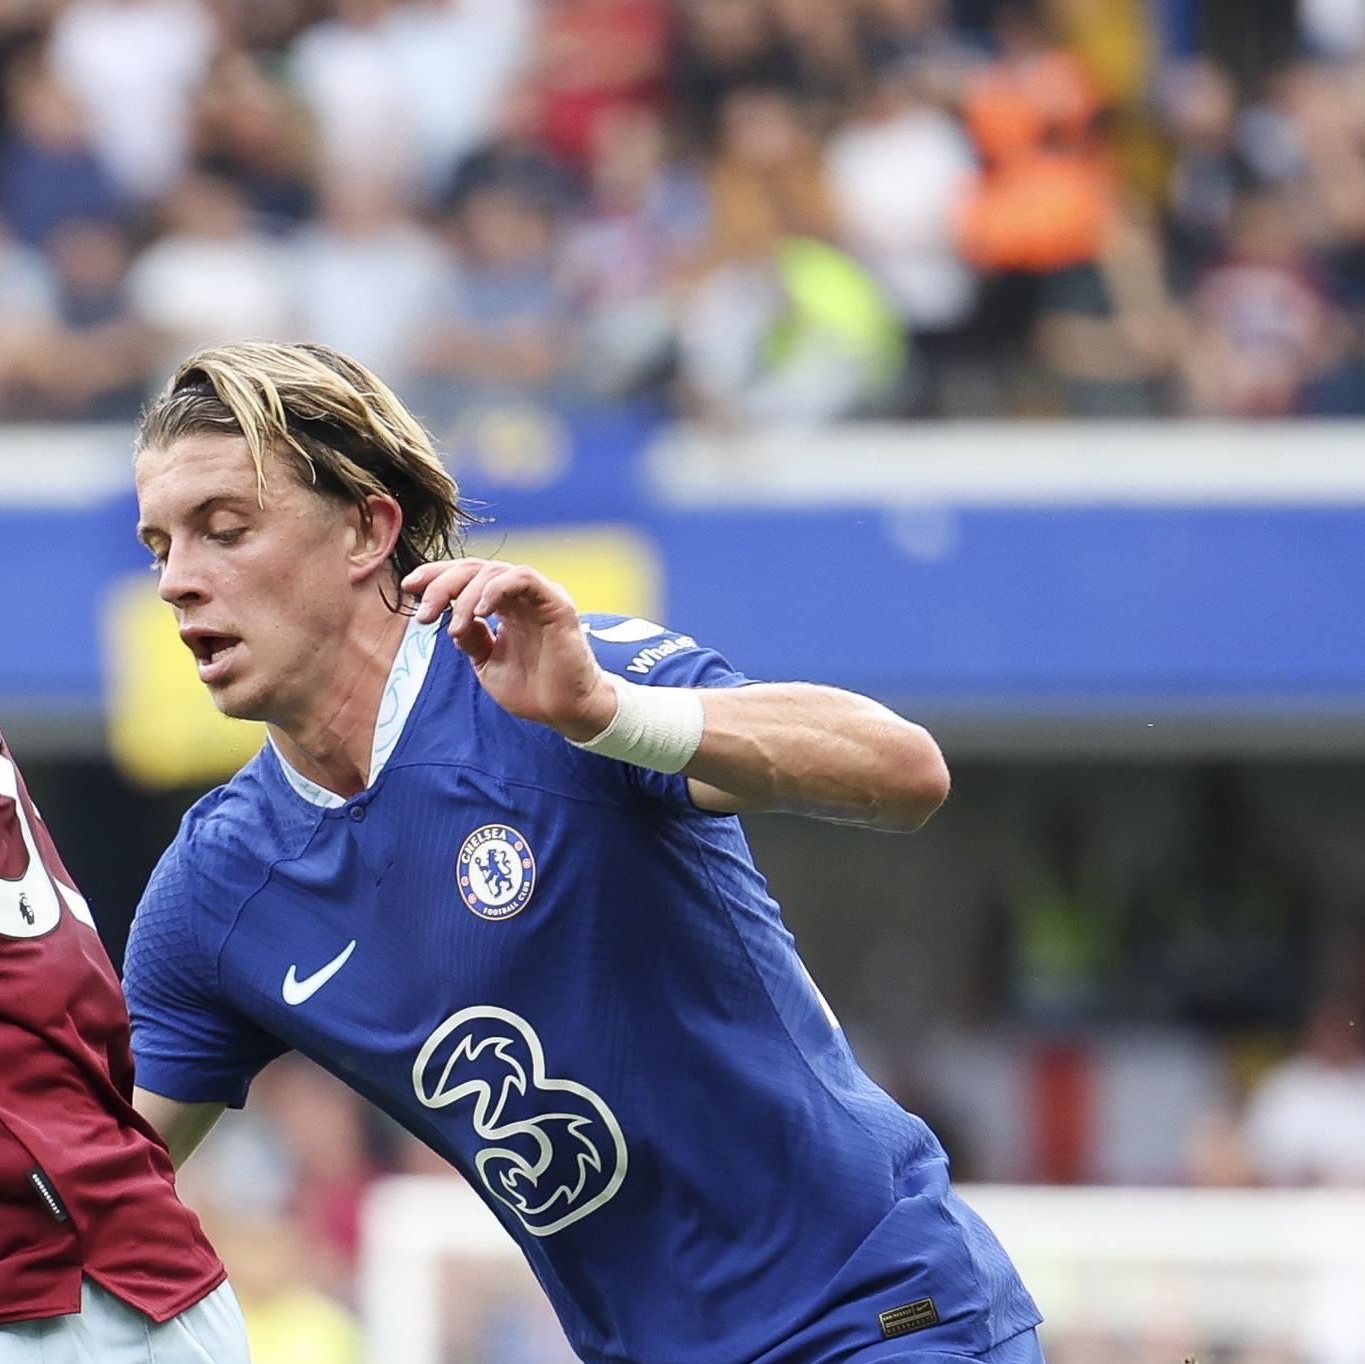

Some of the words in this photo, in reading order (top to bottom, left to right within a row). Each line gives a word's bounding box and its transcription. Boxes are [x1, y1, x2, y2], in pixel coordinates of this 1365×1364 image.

[461, 828, 507, 864] CHELSEA
[483, 901, 519, 916] FOOTBALL
[518, 881, 531, 902] CLUB
